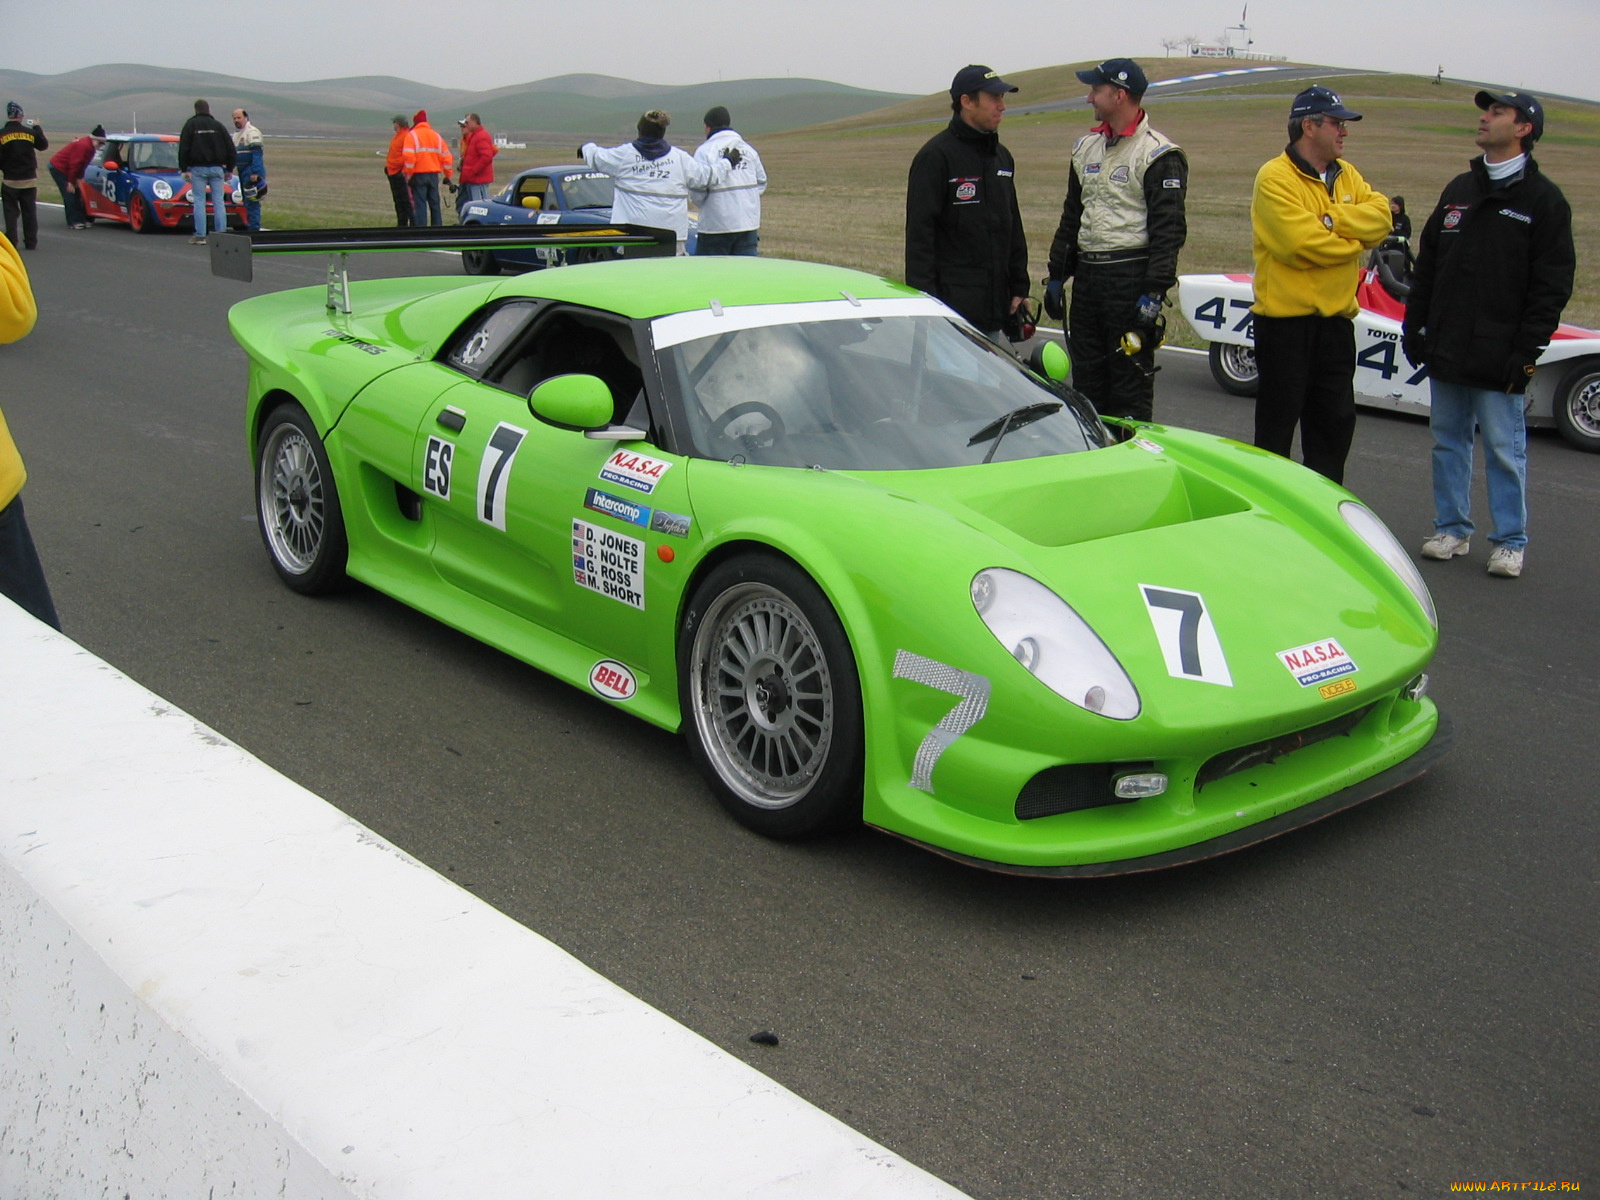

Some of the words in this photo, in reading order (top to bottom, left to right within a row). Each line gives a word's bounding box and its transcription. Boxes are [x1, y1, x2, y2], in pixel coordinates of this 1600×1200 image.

[102, 175, 116, 202] 13
[564, 174, 582, 182] OFF
[649, 170, 670, 179] #72
[1194, 296, 1255, 332] 47
[347, 338, 387, 355] TIRES
[1367, 328, 1398, 341] TOYO
[425, 438, 452, 497] ES
[484, 425, 524, 522] 7
[609, 451, 664, 478] N.A.S.A.
[602, 471, 650, 491] PRO-RACING
[593, 491, 640, 521] Intercomp
[586, 527, 597, 543] D.
[600, 533, 638, 557] JONES
[586, 544, 597, 559] G.
[600, 549, 638, 574] NOLTE
[586, 560, 598, 575] G.
[601, 565, 631, 587] ROSS
[587, 574, 600, 590] M.
[603, 580, 641, 606] SHORT
[1143, 587, 1204, 677] 7
[1285, 642, 1345, 670] N.A.S.A.
[594, 665, 629, 695] BELL
[1301, 664, 1352, 683] PRO-RACING
[1321, 680, 1354, 697] NOBLE
[892, 649, 992, 795] 7
